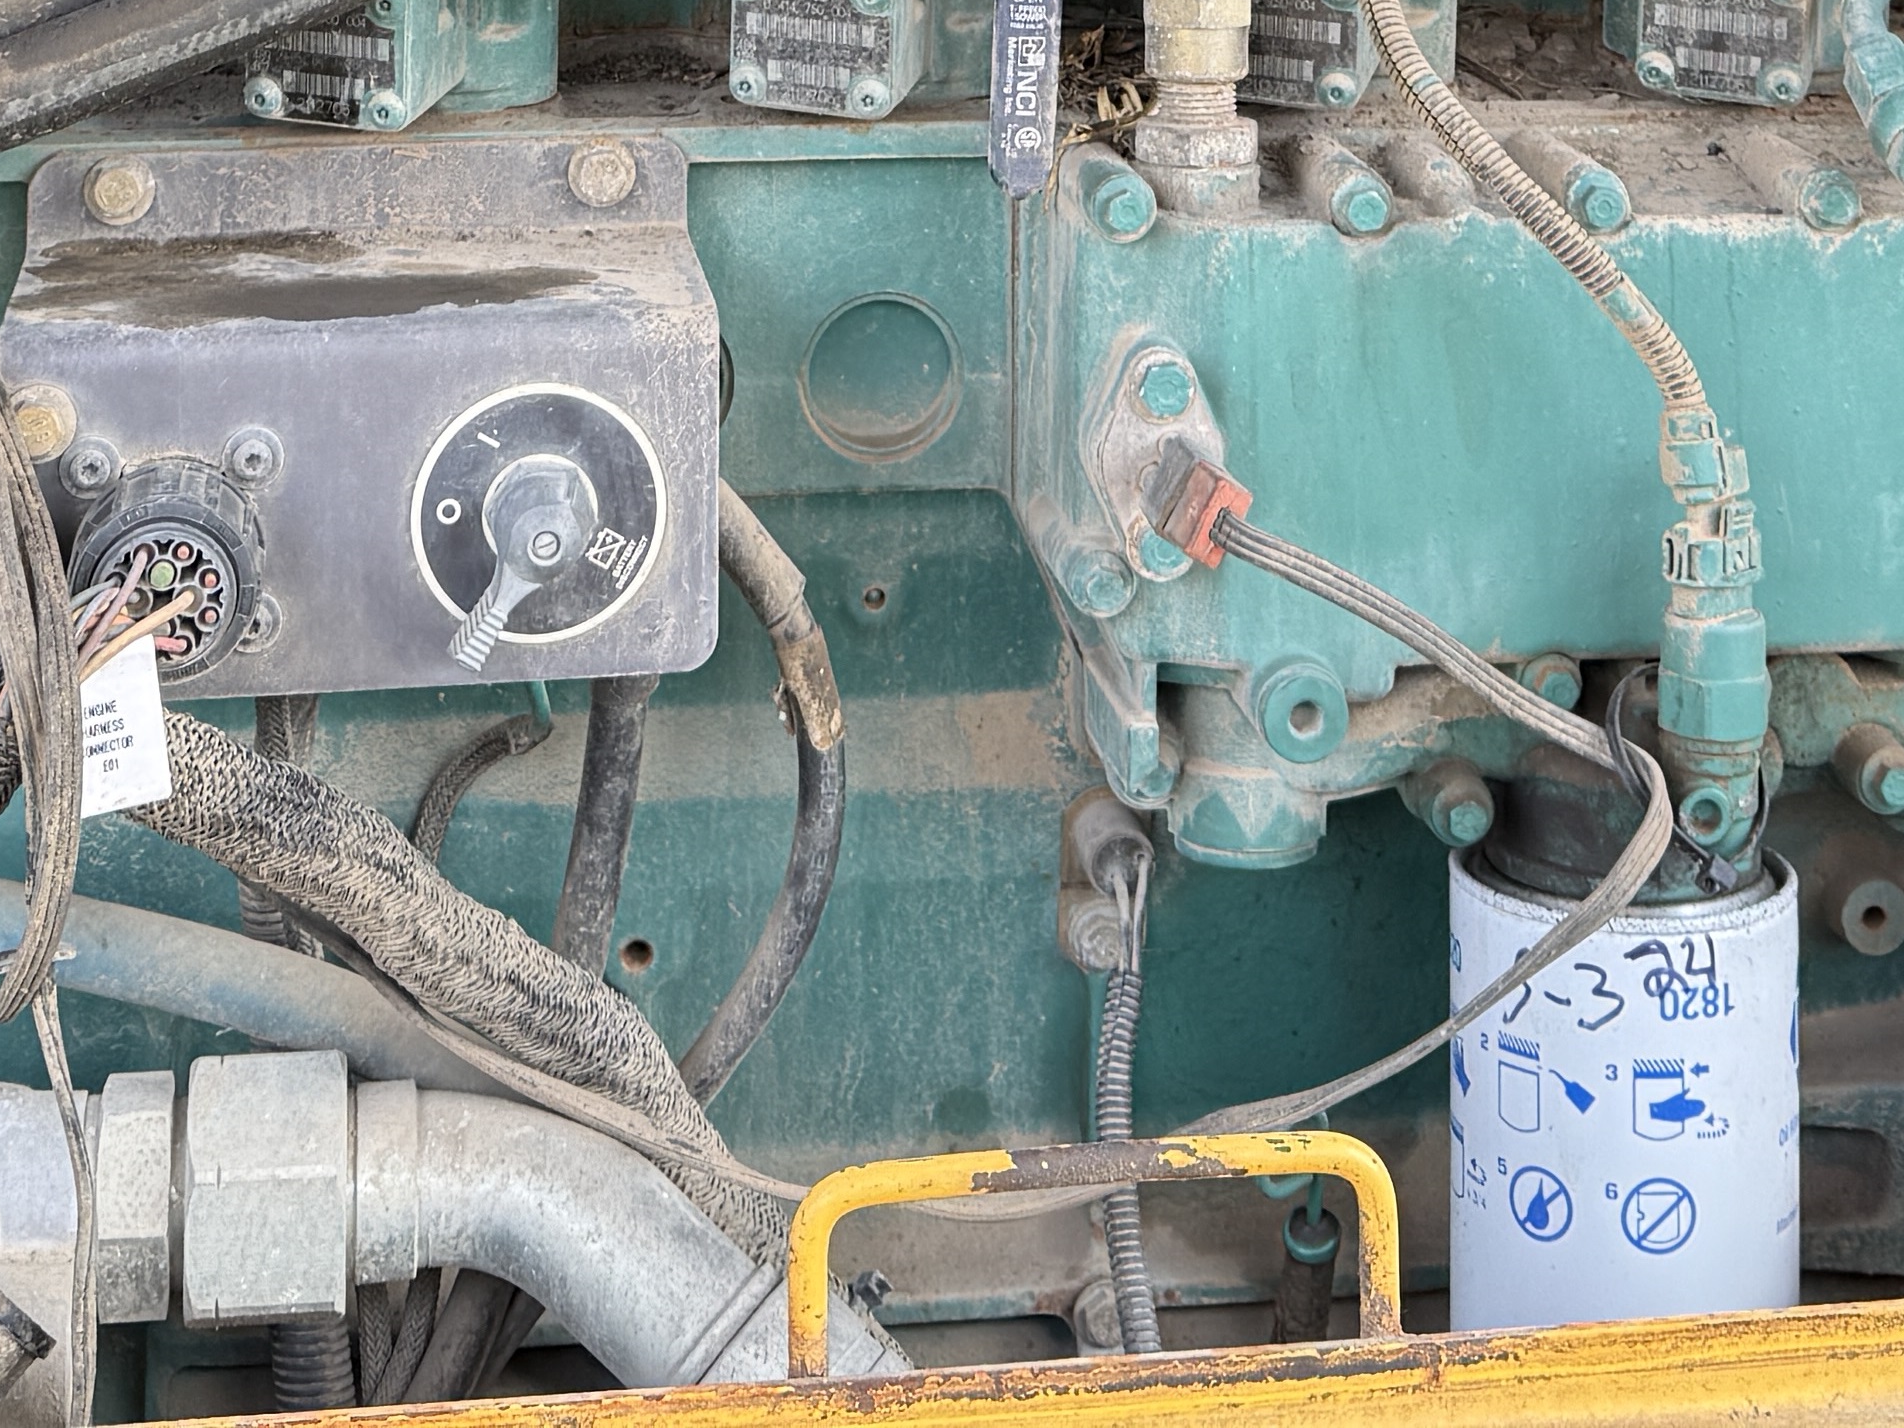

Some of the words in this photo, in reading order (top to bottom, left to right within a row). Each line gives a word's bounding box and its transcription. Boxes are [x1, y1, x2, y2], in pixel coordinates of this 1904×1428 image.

[1015, 70, 1038, 116] NCI
[612, 538, 637, 578] BATTERY
[1660, 982, 1736, 1021] 1820
[1480, 1033, 1490, 1051] 2
[1605, 1064, 1619, 1082] 3
[1497, 1157, 1507, 1175] 5
[1605, 1183, 1618, 1201] 6
